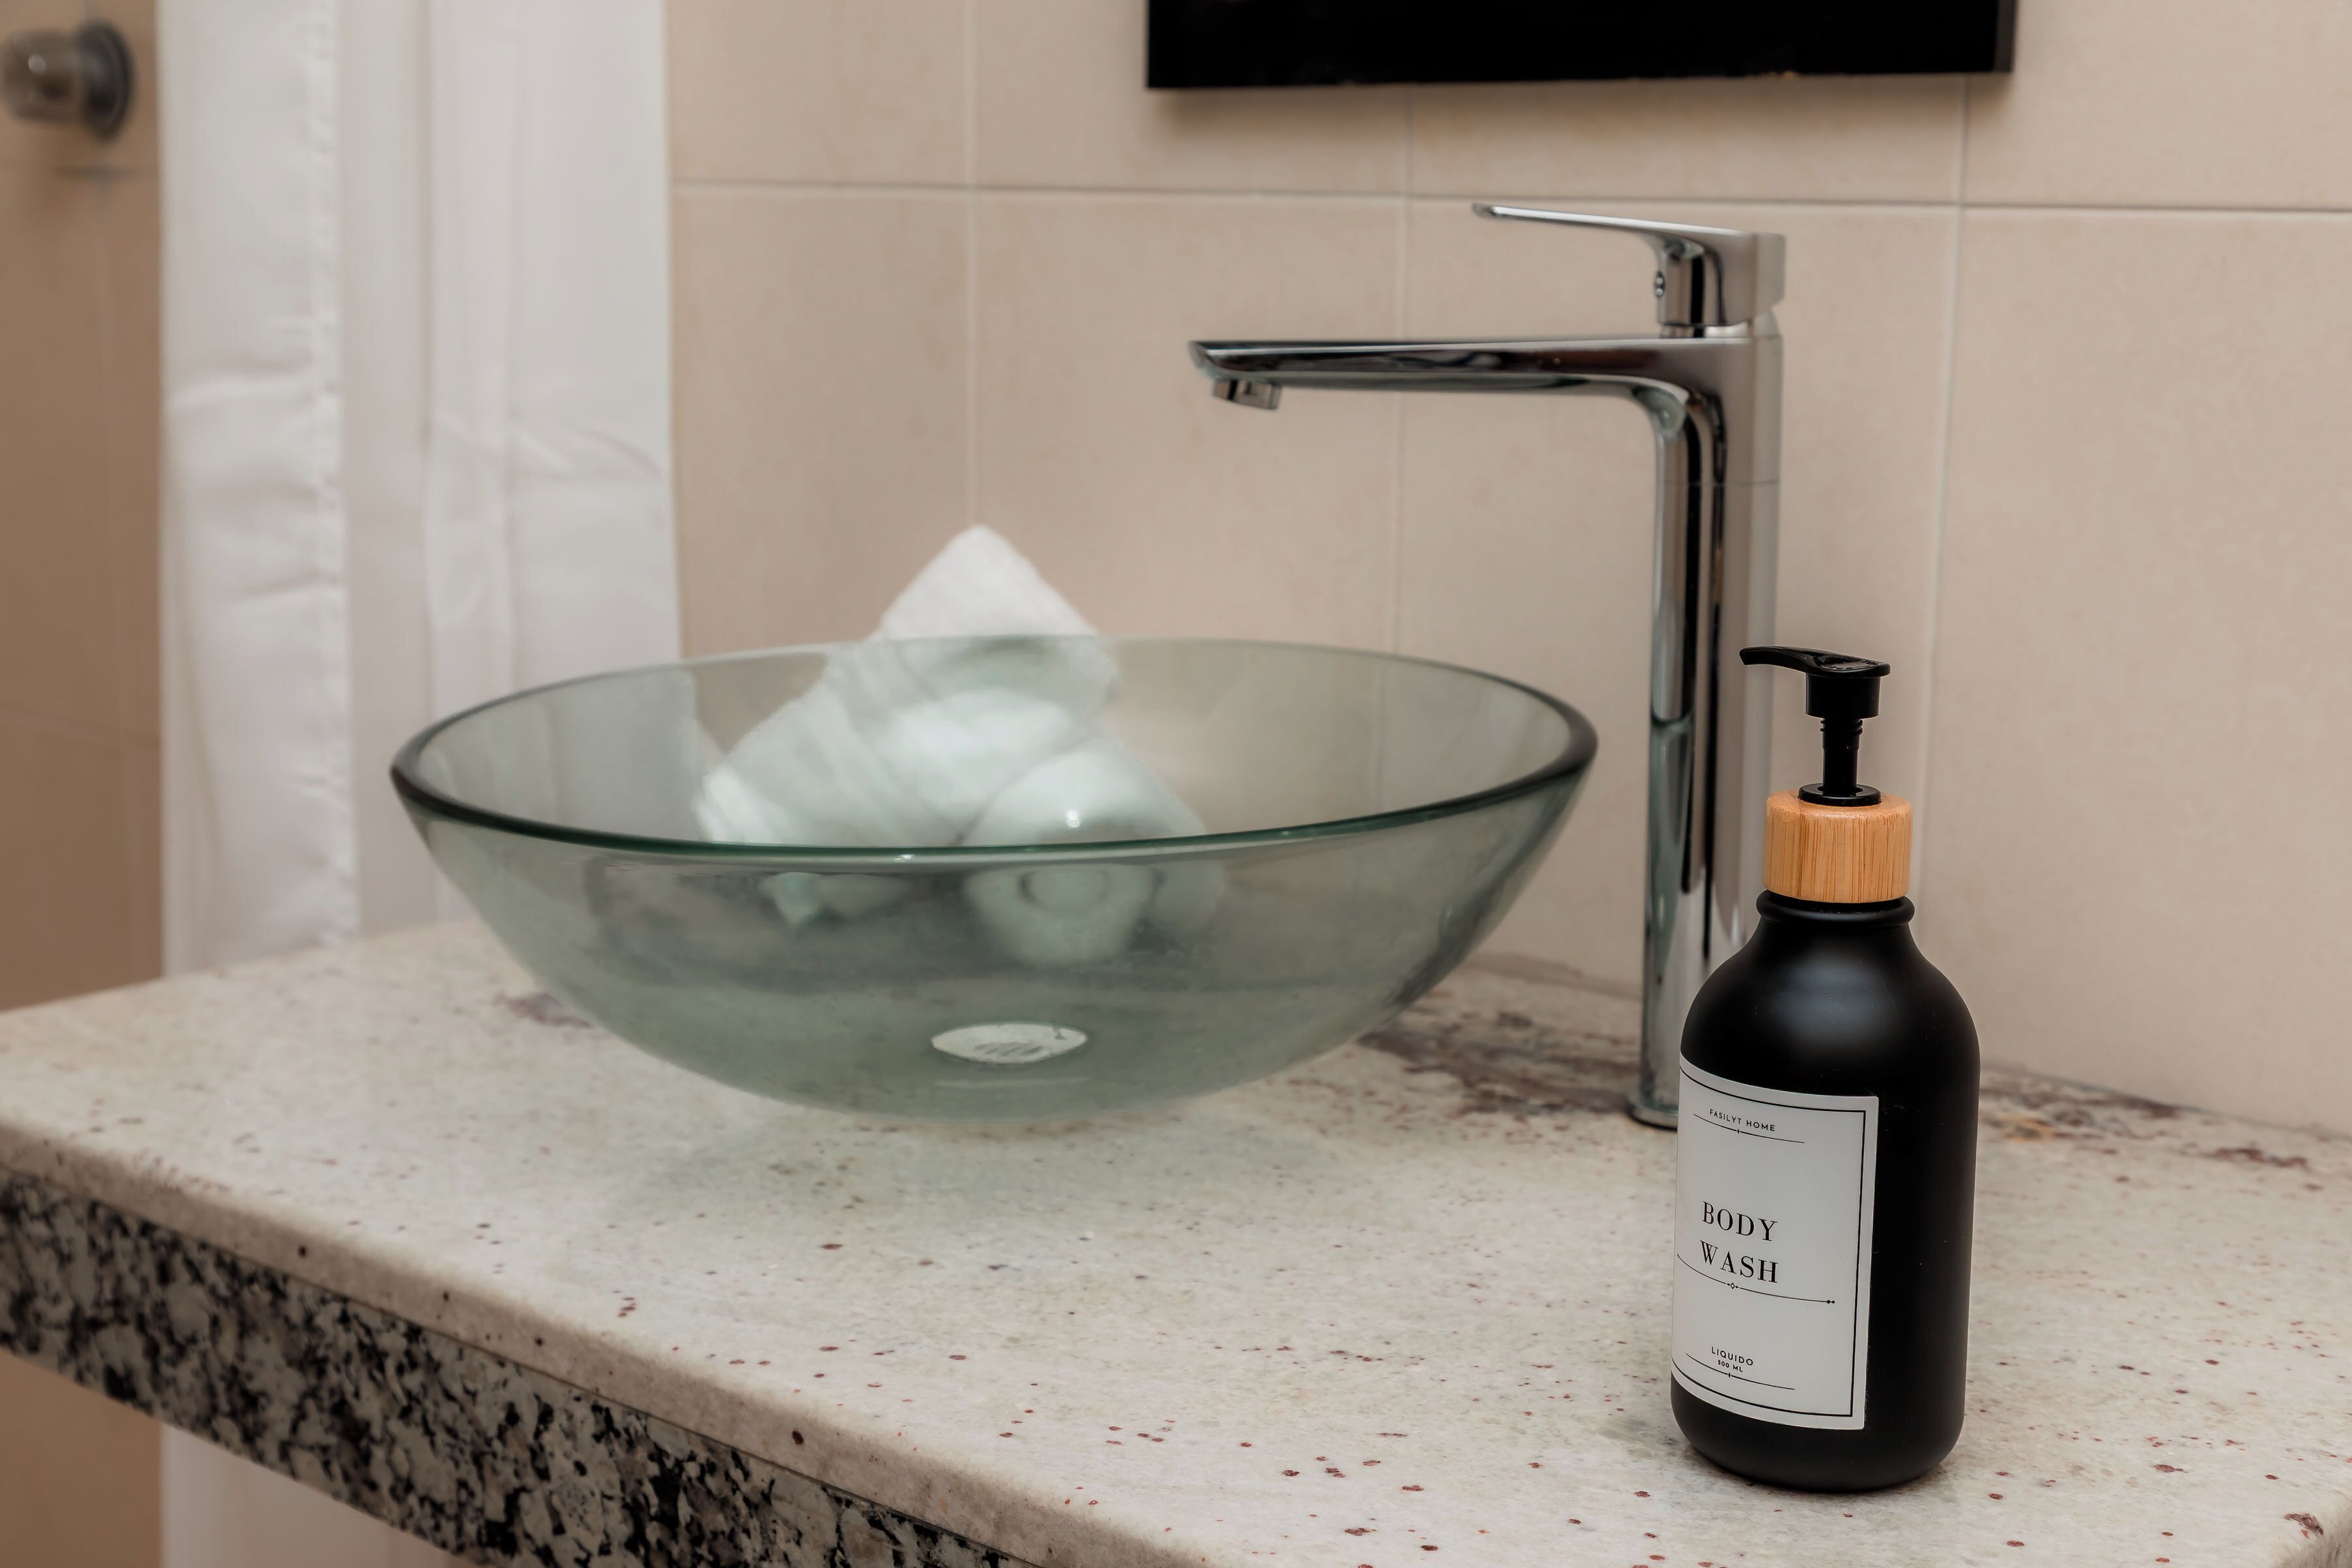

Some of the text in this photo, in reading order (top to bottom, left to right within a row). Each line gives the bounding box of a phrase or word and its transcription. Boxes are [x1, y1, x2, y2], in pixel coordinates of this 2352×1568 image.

[1710, 1109, 1776, 1132] FASILYT HOME
[1702, 1201, 1778, 1241] BODY
[1700, 1240, 1778, 1283] WASH
[1711, 1346, 1754, 1366] LIQUIDO
[1718, 1360, 1743, 1373] 500 ML
